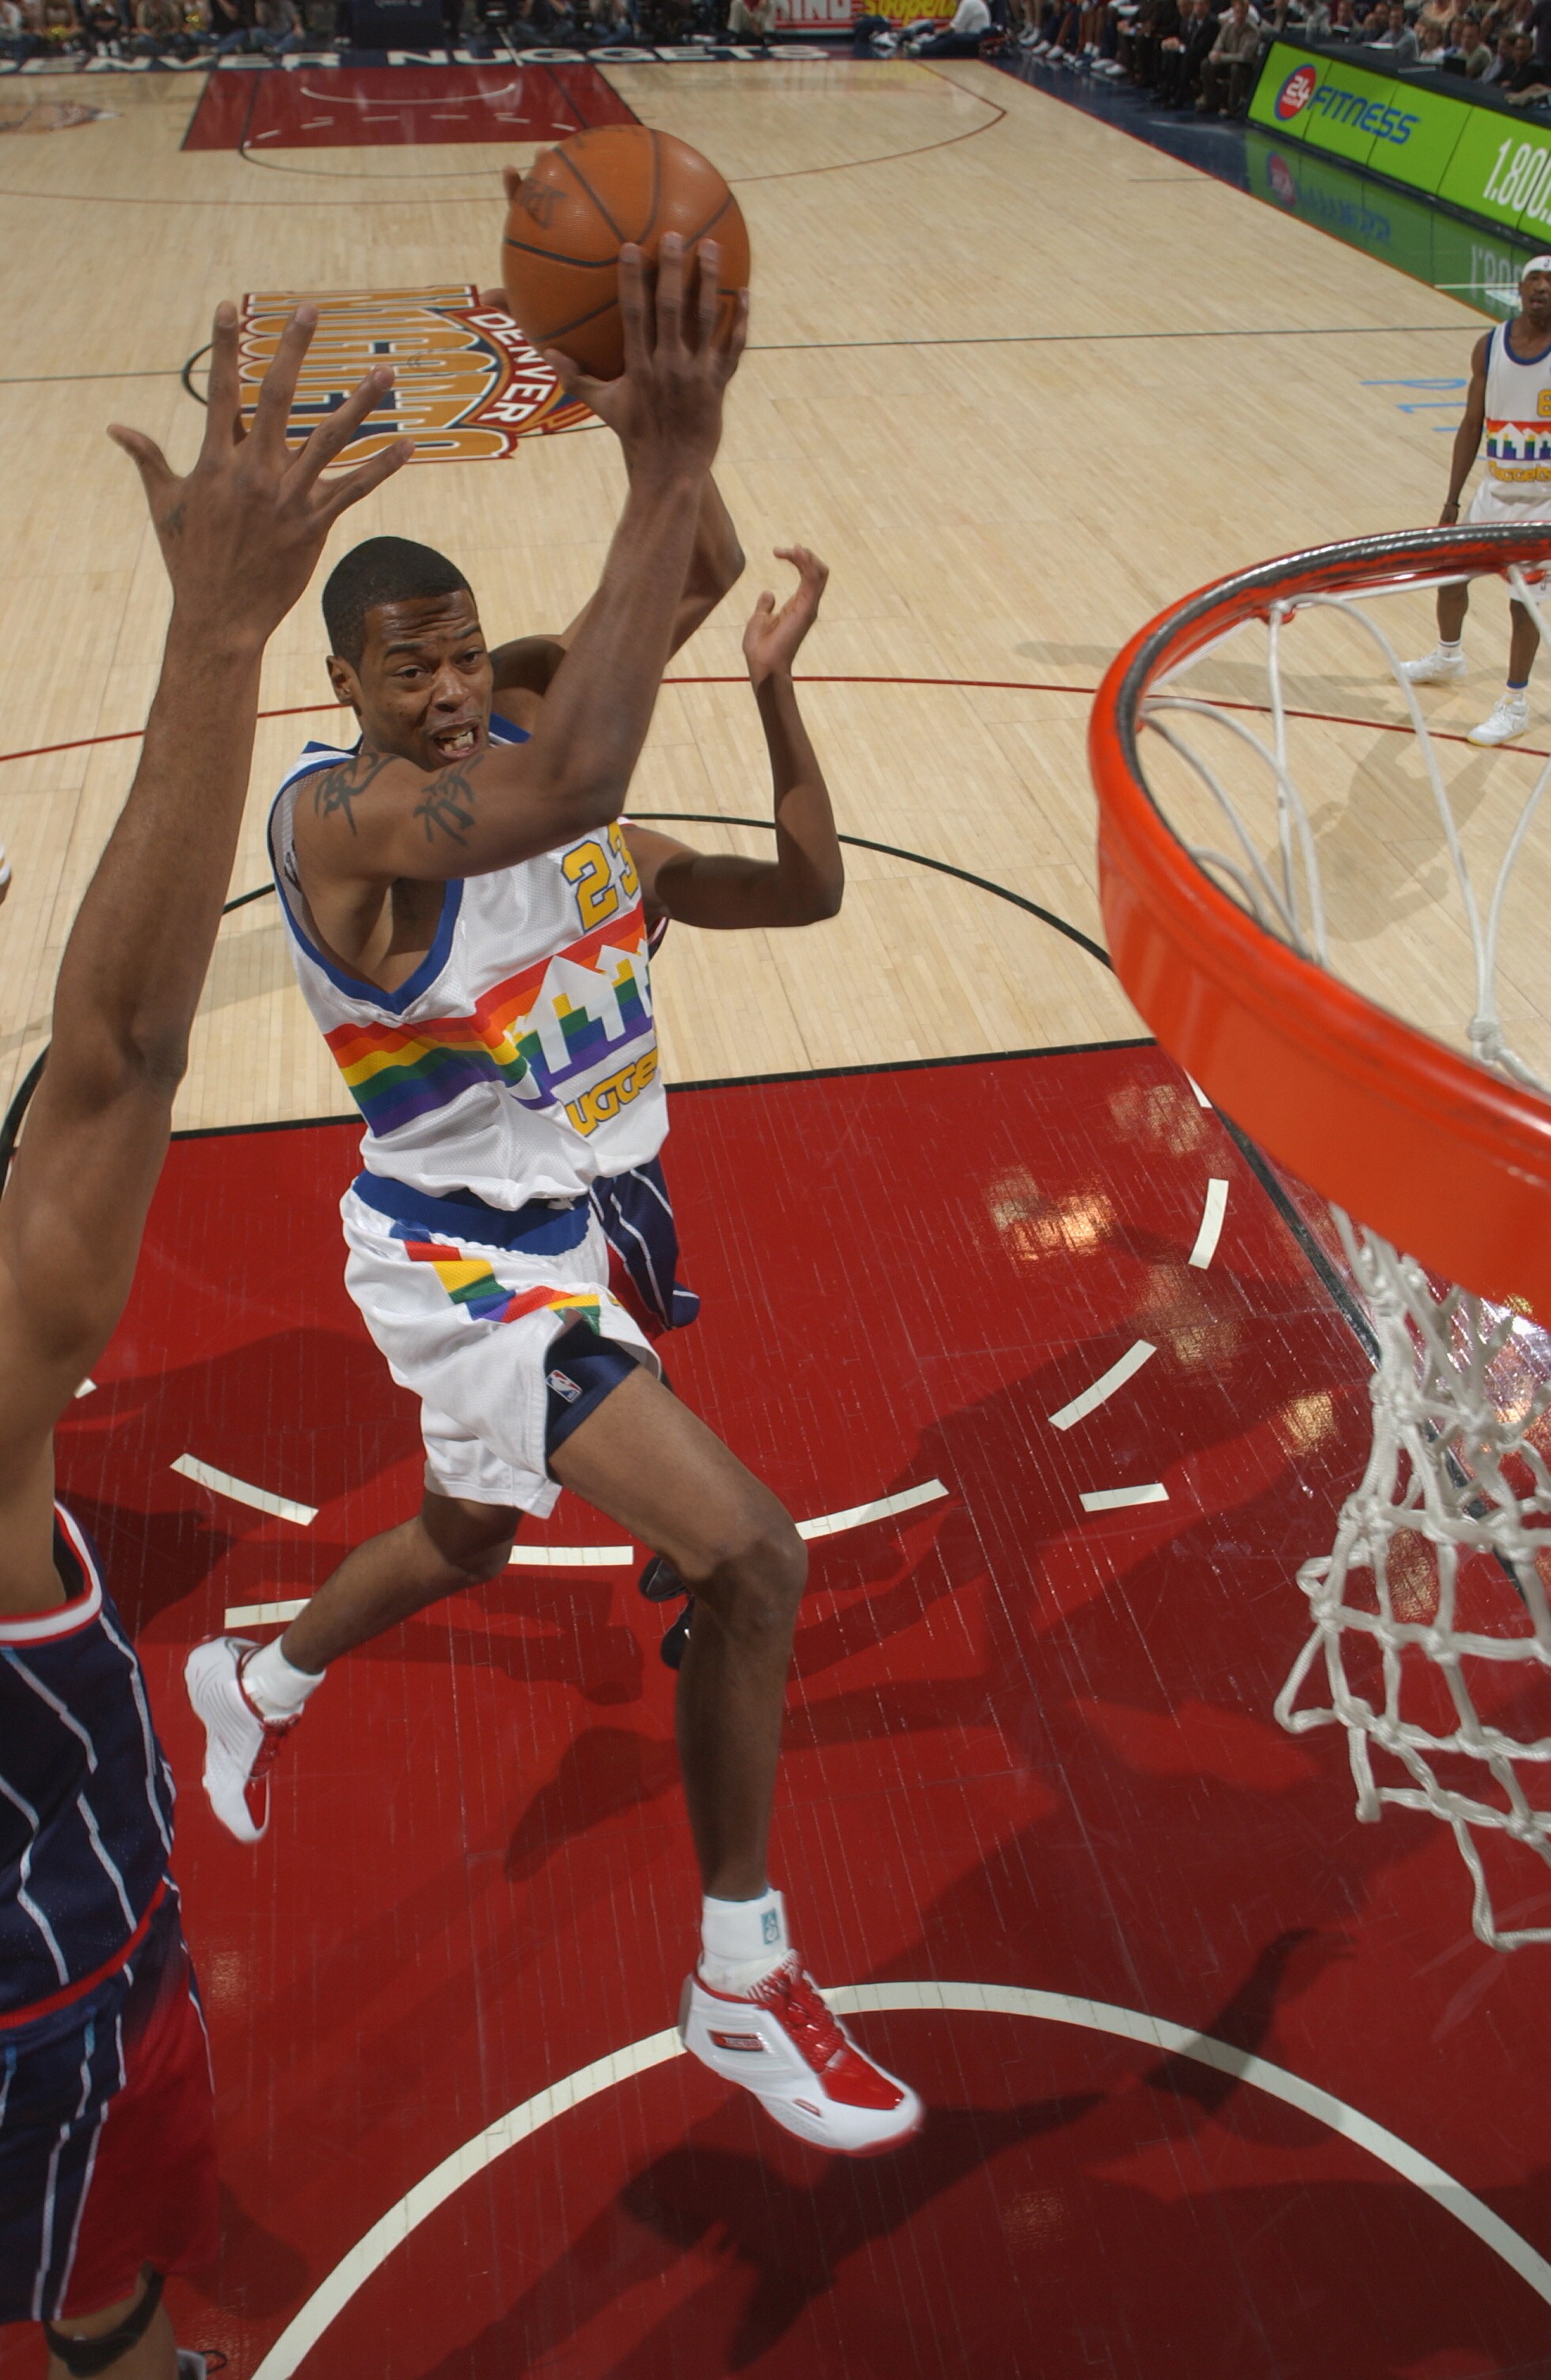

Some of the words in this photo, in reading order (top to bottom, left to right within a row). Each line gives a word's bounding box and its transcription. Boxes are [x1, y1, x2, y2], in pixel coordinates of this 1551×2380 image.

[386, 45, 829, 66] NUGGETS
[1285, 74, 1310, 109] 24
[1307, 85, 1420, 145] FITNESS
[1483, 138, 1551, 226] 1.800.
[467, 313, 557, 423] DENVER
[560, 820, 639, 934] 23
